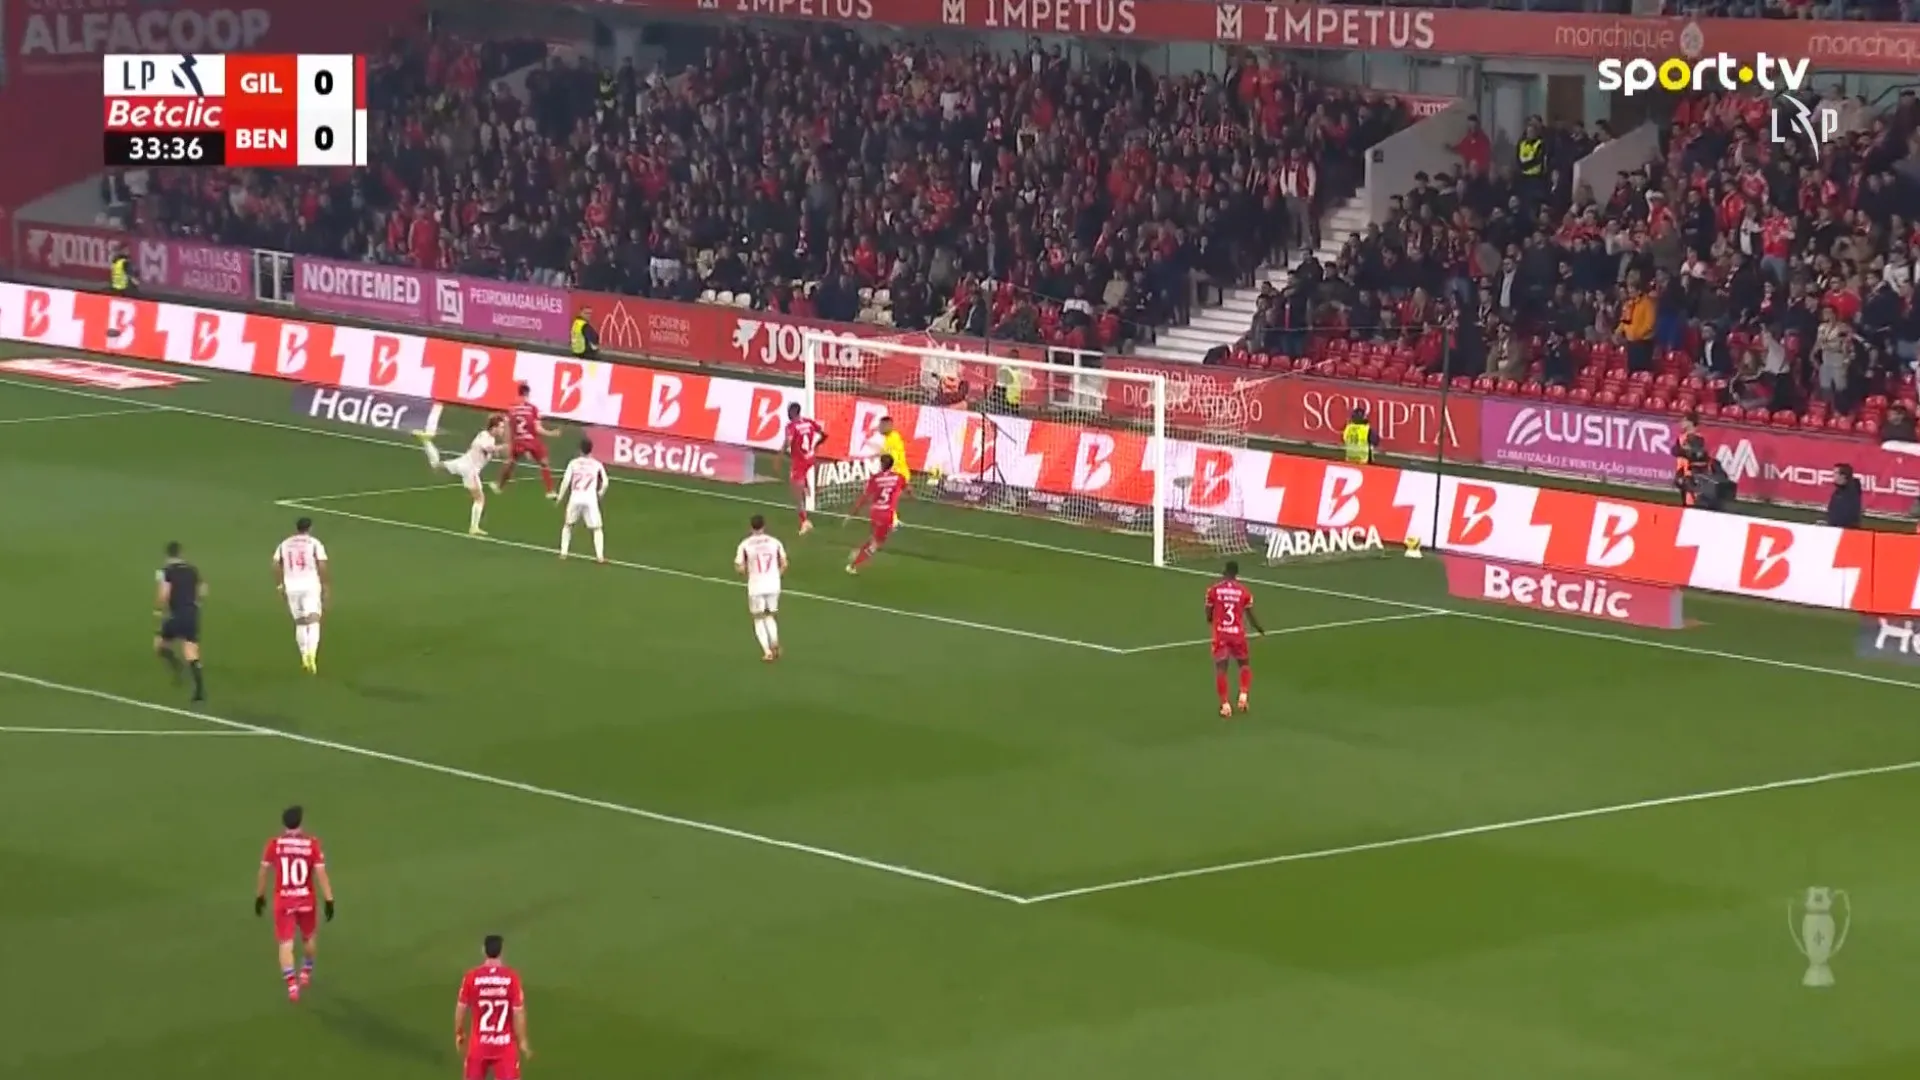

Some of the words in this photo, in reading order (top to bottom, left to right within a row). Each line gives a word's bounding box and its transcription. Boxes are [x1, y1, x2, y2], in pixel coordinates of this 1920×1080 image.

[20, 9, 271, 54] ALFACOOP
[985, 1, 1136, 33] IMPETUS
[1264, 6, 1435, 48] IMPETUS
[1555, 22, 1674, 51] monchique
[302, 263, 420, 303] NORTEMED
[309, 388, 407, 430] Haier
[516, 416, 528, 433] 2
[1545, 409, 1671, 454] LUSITAR
[613, 435, 719, 476] Betclic
[572, 472, 595, 491] 27
[826, 459, 881, 485] ABAN
[1625, 465, 1675, 480] INDUSTRIA
[879, 487, 892, 505] 5
[1276, 525, 1383, 556] ABANCA
[288, 551, 306, 571] 14
[756, 552, 773, 574] 17
[1483, 563, 1632, 618] Betclic
[1222, 602, 1235, 626] 3
[280, 856, 309, 887] 10
[478, 1000, 509, 1033] 27
